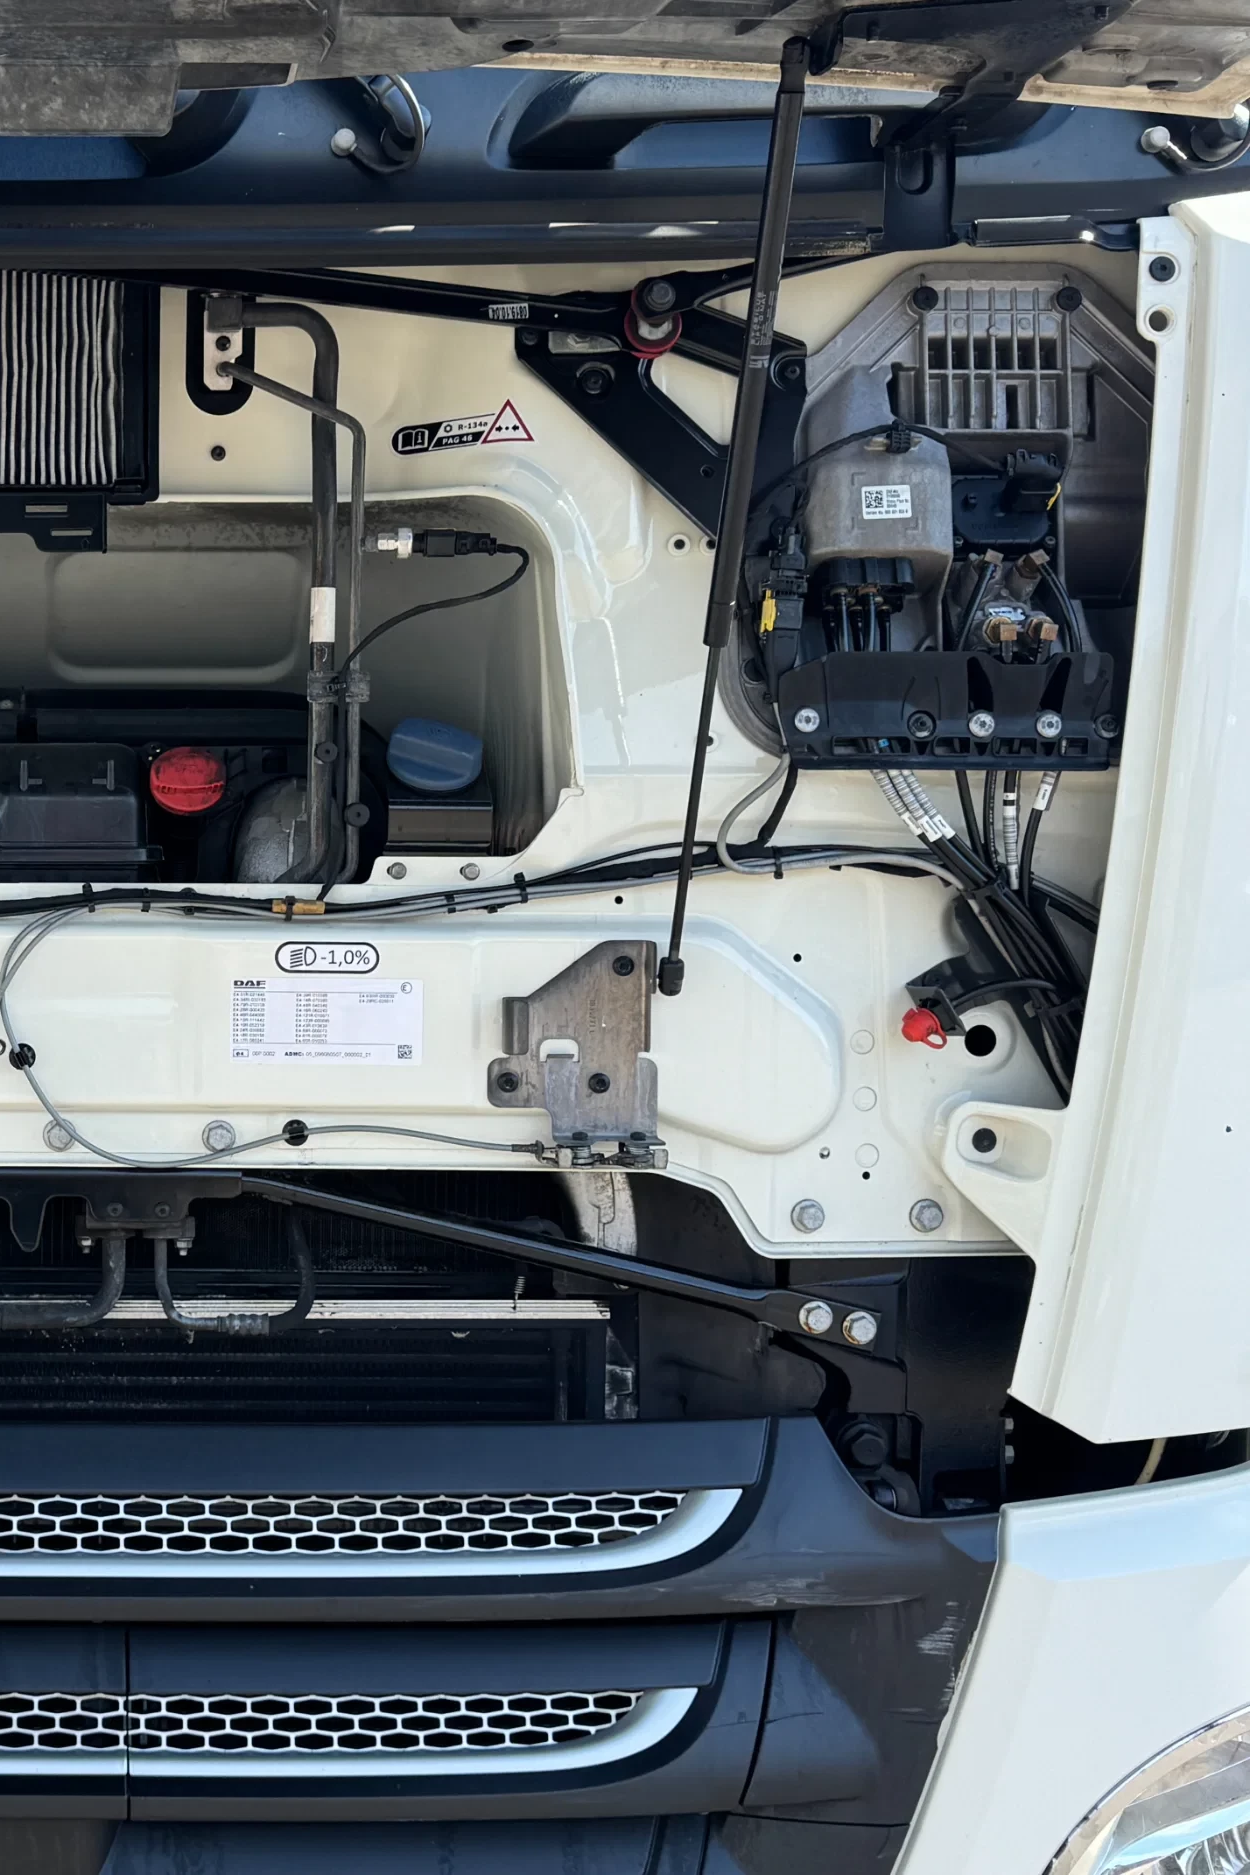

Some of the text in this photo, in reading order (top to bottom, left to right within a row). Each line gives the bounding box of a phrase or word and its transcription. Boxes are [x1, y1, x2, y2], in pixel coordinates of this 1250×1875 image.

[458, 420, 488, 431] R-134a
[442, 437, 460, 445] PAG
[320, 950, 370, 967] -1,0%
